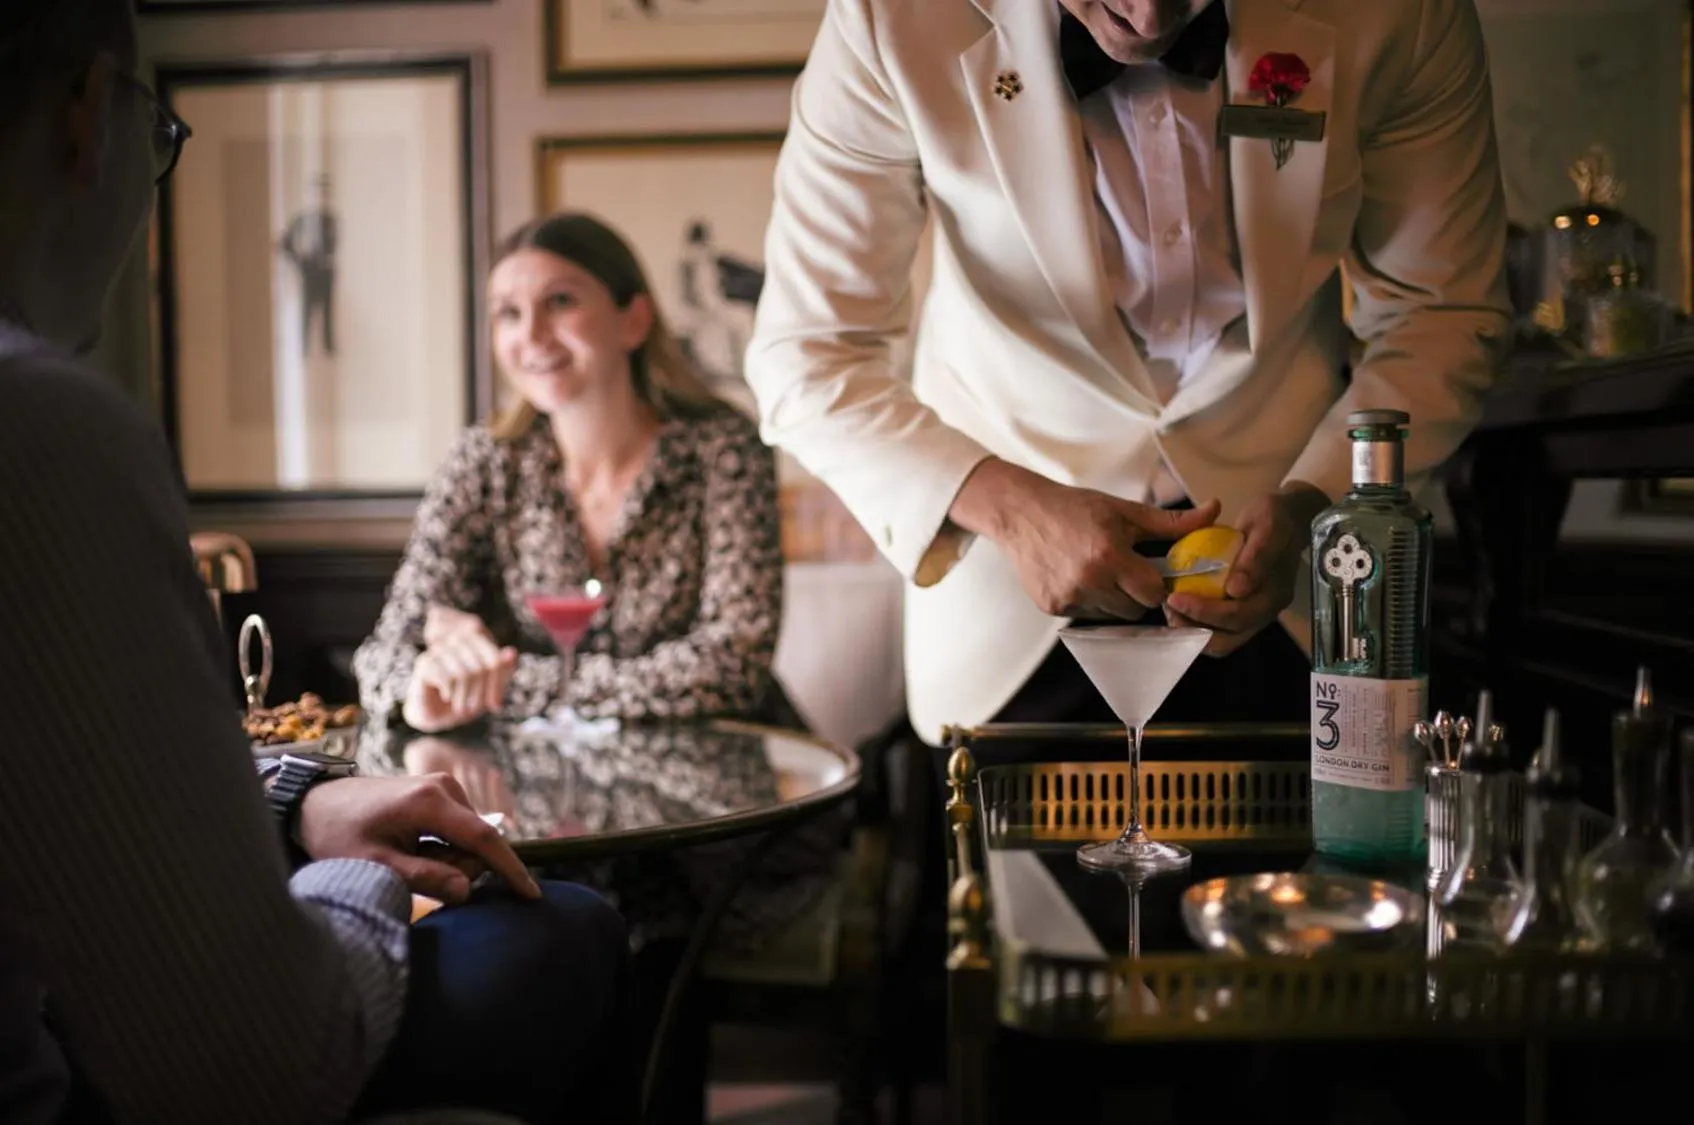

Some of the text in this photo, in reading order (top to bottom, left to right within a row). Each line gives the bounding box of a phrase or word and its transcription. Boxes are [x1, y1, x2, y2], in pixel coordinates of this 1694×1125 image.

[1316, 700, 1340, 750] 3
[1316, 755, 1390, 772] LONDON DRY GIN
